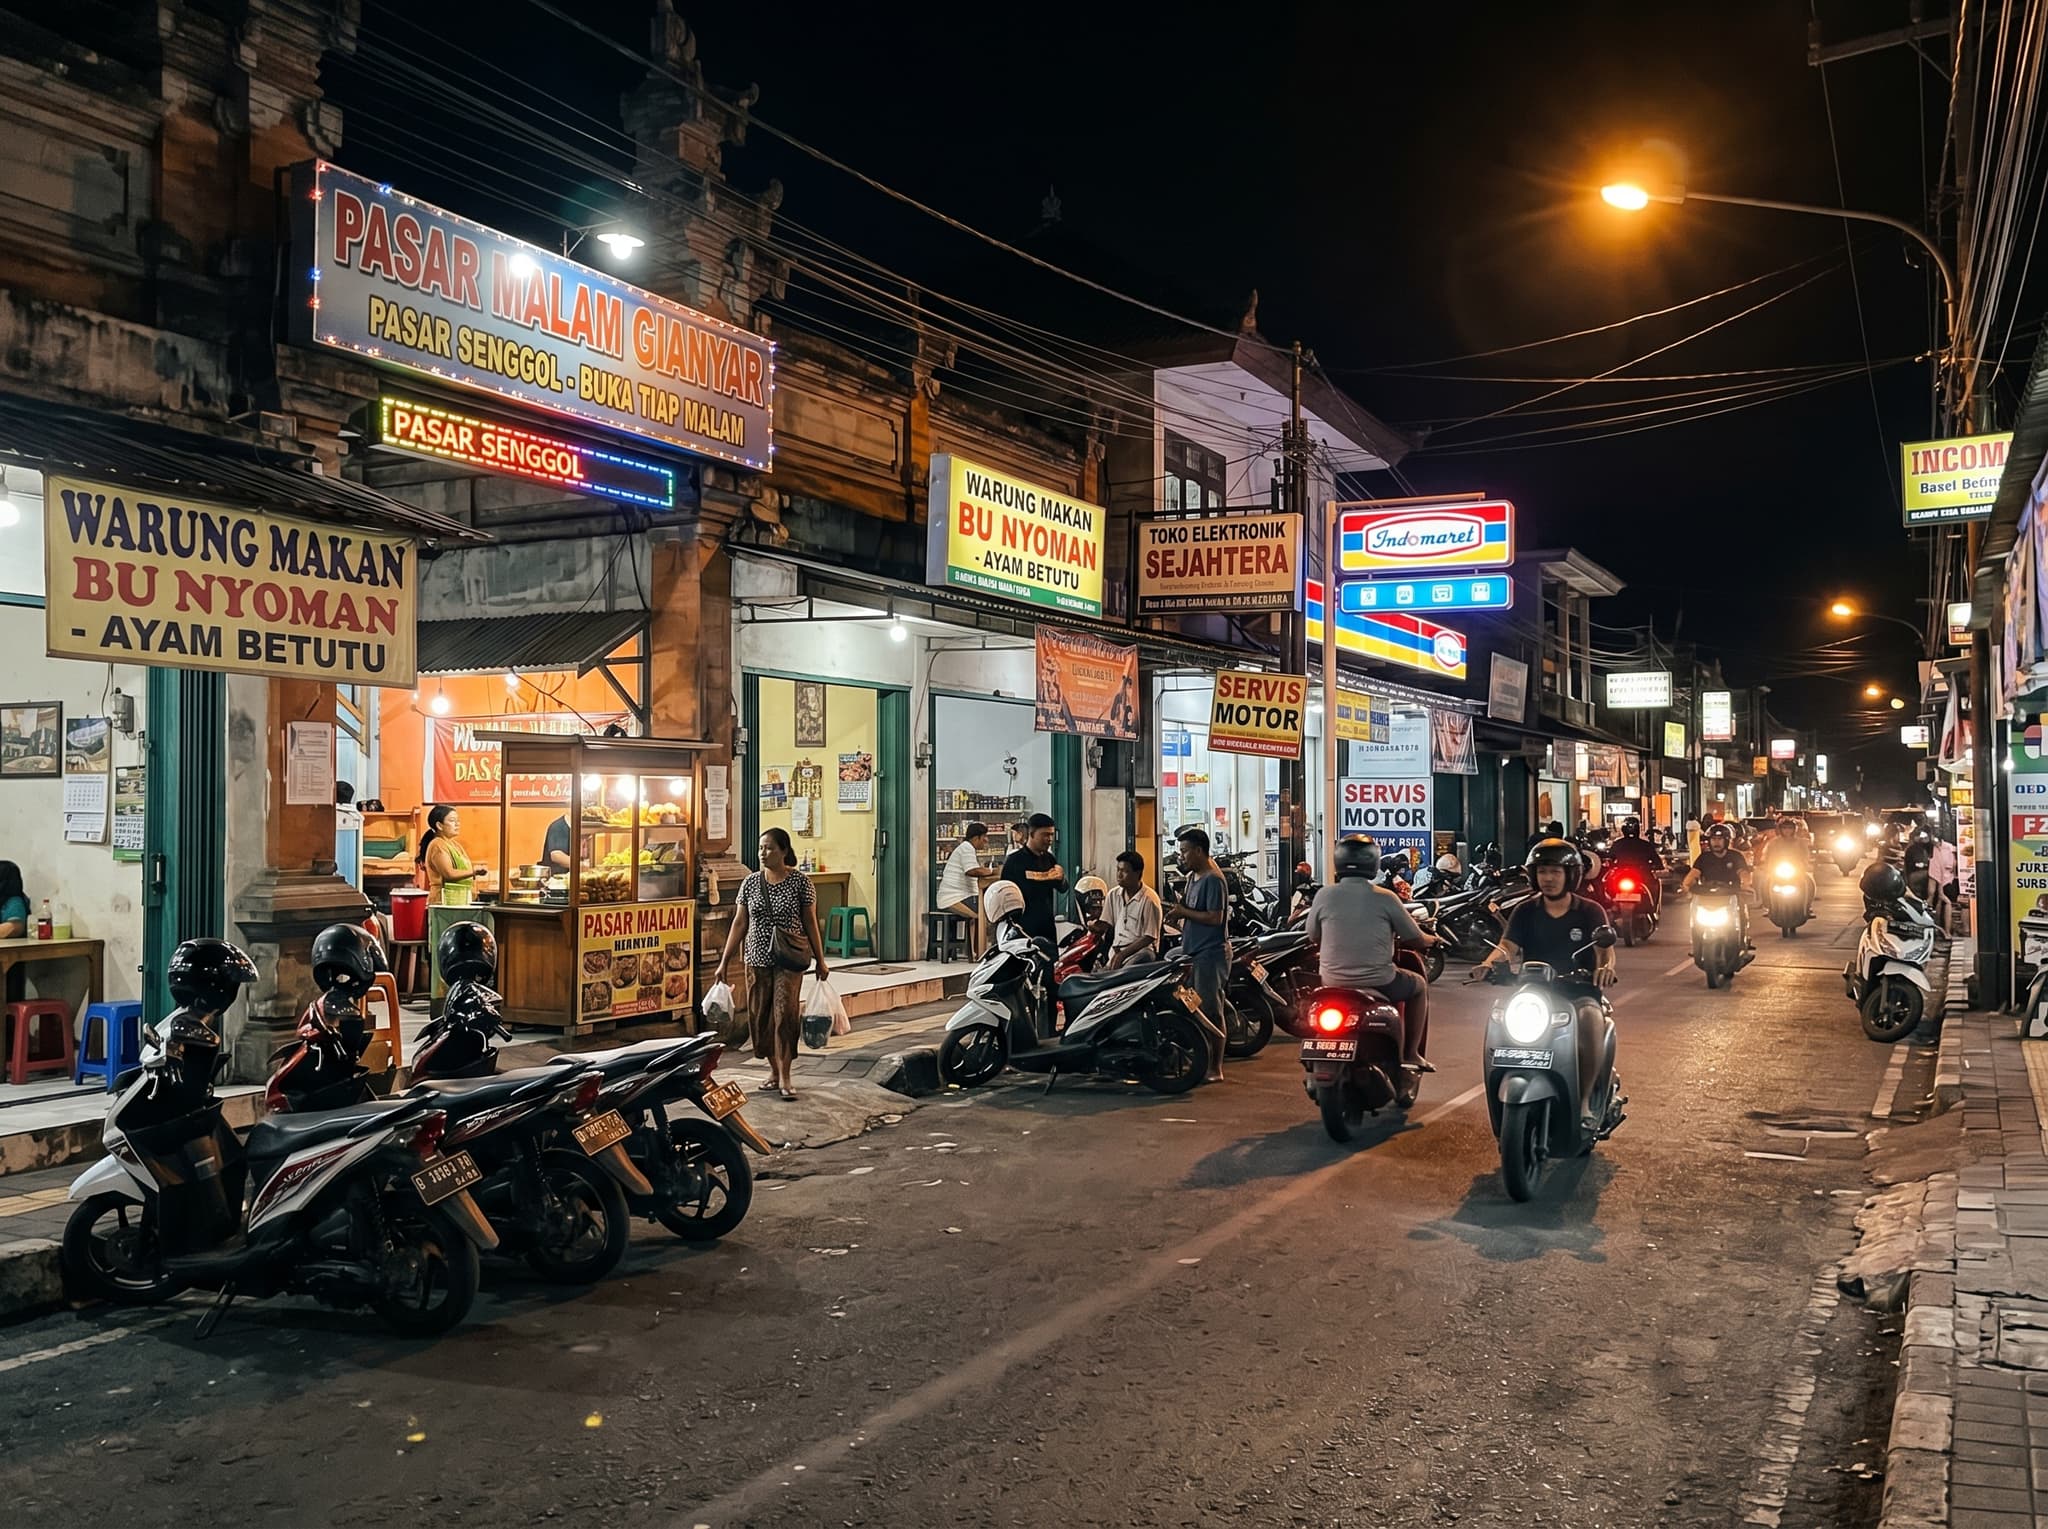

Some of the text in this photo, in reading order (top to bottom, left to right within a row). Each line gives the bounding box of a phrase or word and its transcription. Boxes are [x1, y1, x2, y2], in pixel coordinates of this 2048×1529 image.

[333, 189, 764, 408] PASAR MALAM GIANYAR
[368, 295, 451, 358] PASAR
[457, 325, 563, 392] SENGGOL
[578, 365, 634, 413] BUKA
[638, 383, 680, 426] TIAP
[683, 400, 745, 448] MALAM
[393, 408, 584, 480] PASAR SENGGOL
[1912, 441, 2012, 476] INCOM
[965, 471, 1093, 533] WARUNG MAKAN
[61, 489, 405, 590] WARUNG MAKAN
[958, 502, 1098, 571] BU NYOMAN
[1149, 521, 1286, 545] TOKO ELEKTRONIK
[1372, 525, 1475, 549] Indomaret
[983, 549, 1022, 579] AYAM
[1026, 558, 1080, 590] BETUTU
[1145, 543, 1289, 580] SEJAHTERA
[72, 556, 399, 637] BU NYOMAN
[100, 615, 222, 658] AYAM
[237, 632, 386, 673] BETUTU
[1218, 675, 1301, 704] SERVIS
[1215, 702, 1299, 731] MOTOR
[1344, 784, 1426, 804] SERVIS
[1344, 808, 1427, 827] MOTOR
[584, 907, 688, 938] PASAR MALAM
